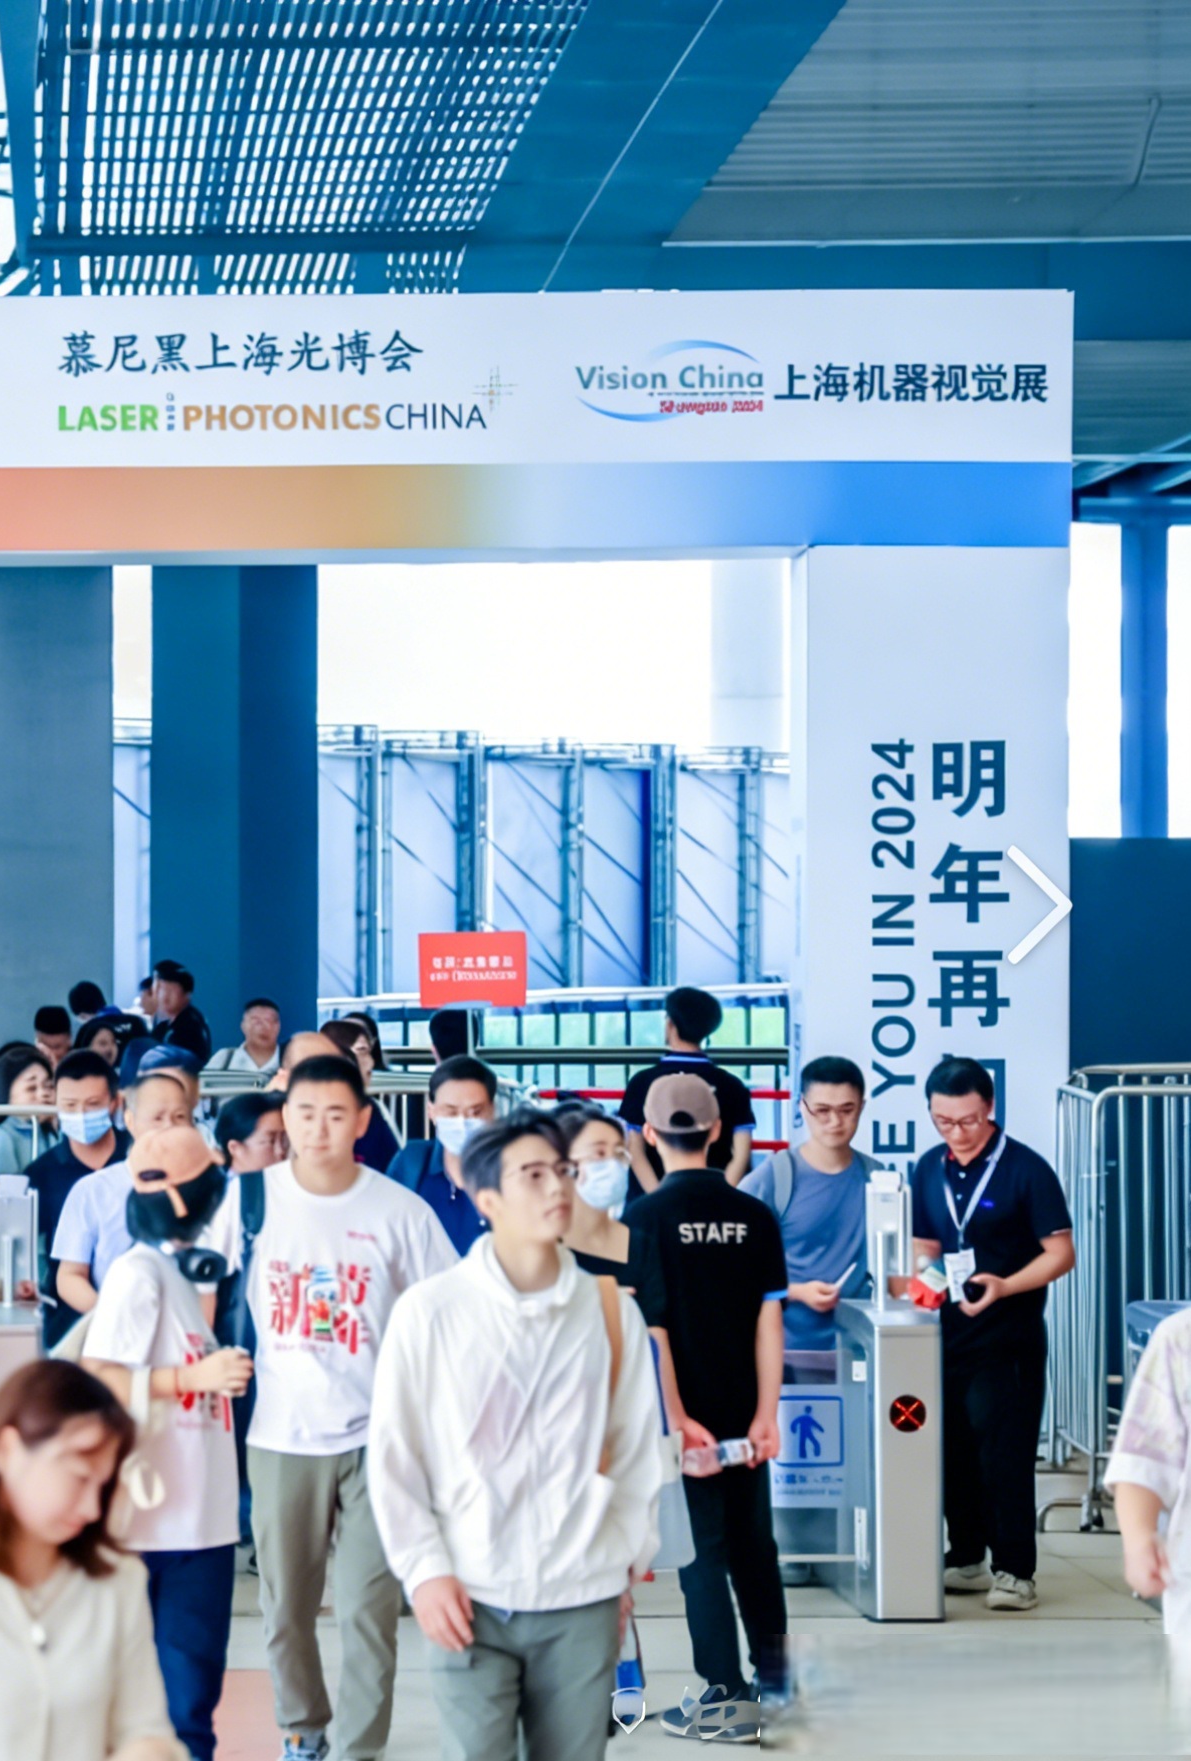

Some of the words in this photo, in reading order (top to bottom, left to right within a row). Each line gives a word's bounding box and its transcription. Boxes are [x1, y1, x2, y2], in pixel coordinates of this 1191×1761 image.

[57, 328, 424, 378] 慕尼黑上海光博会
[575, 365, 668, 390] Vision
[679, 364, 764, 389] China
[773, 361, 1049, 404] 上海机器视觉展
[57, 403, 158, 431] LASER
[871, 738, 916, 870] 2024
[872, 894, 916, 946] IN
[927, 740, 1010, 1132] 明年再
[871, 973, 916, 1098] YOU
[678, 1221, 748, 1245] STAFF
